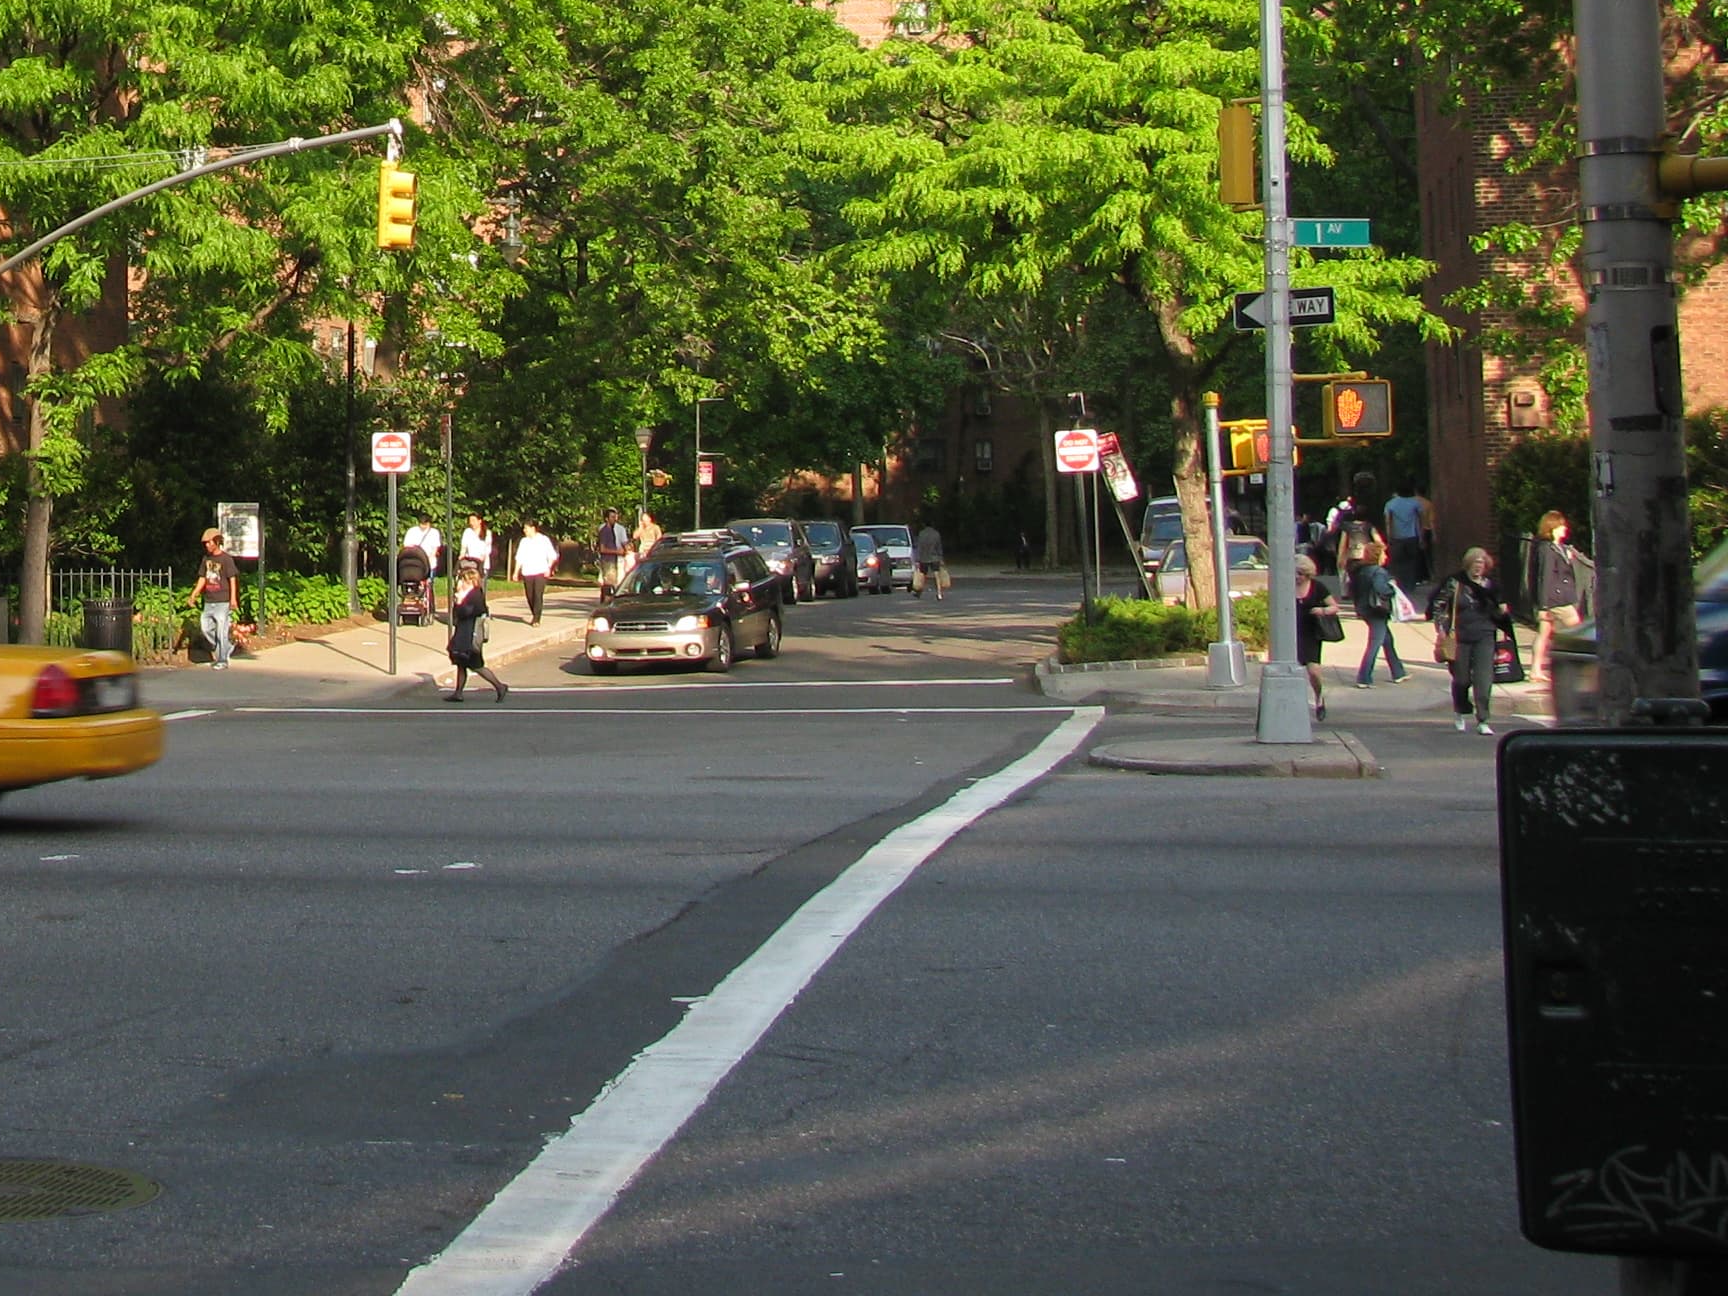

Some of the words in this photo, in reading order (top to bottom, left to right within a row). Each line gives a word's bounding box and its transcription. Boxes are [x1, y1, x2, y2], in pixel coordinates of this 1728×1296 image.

[1315, 222, 1322, 243] 1
[1327, 222, 1344, 234] AV
[1296, 298, 1325, 315] WAY
